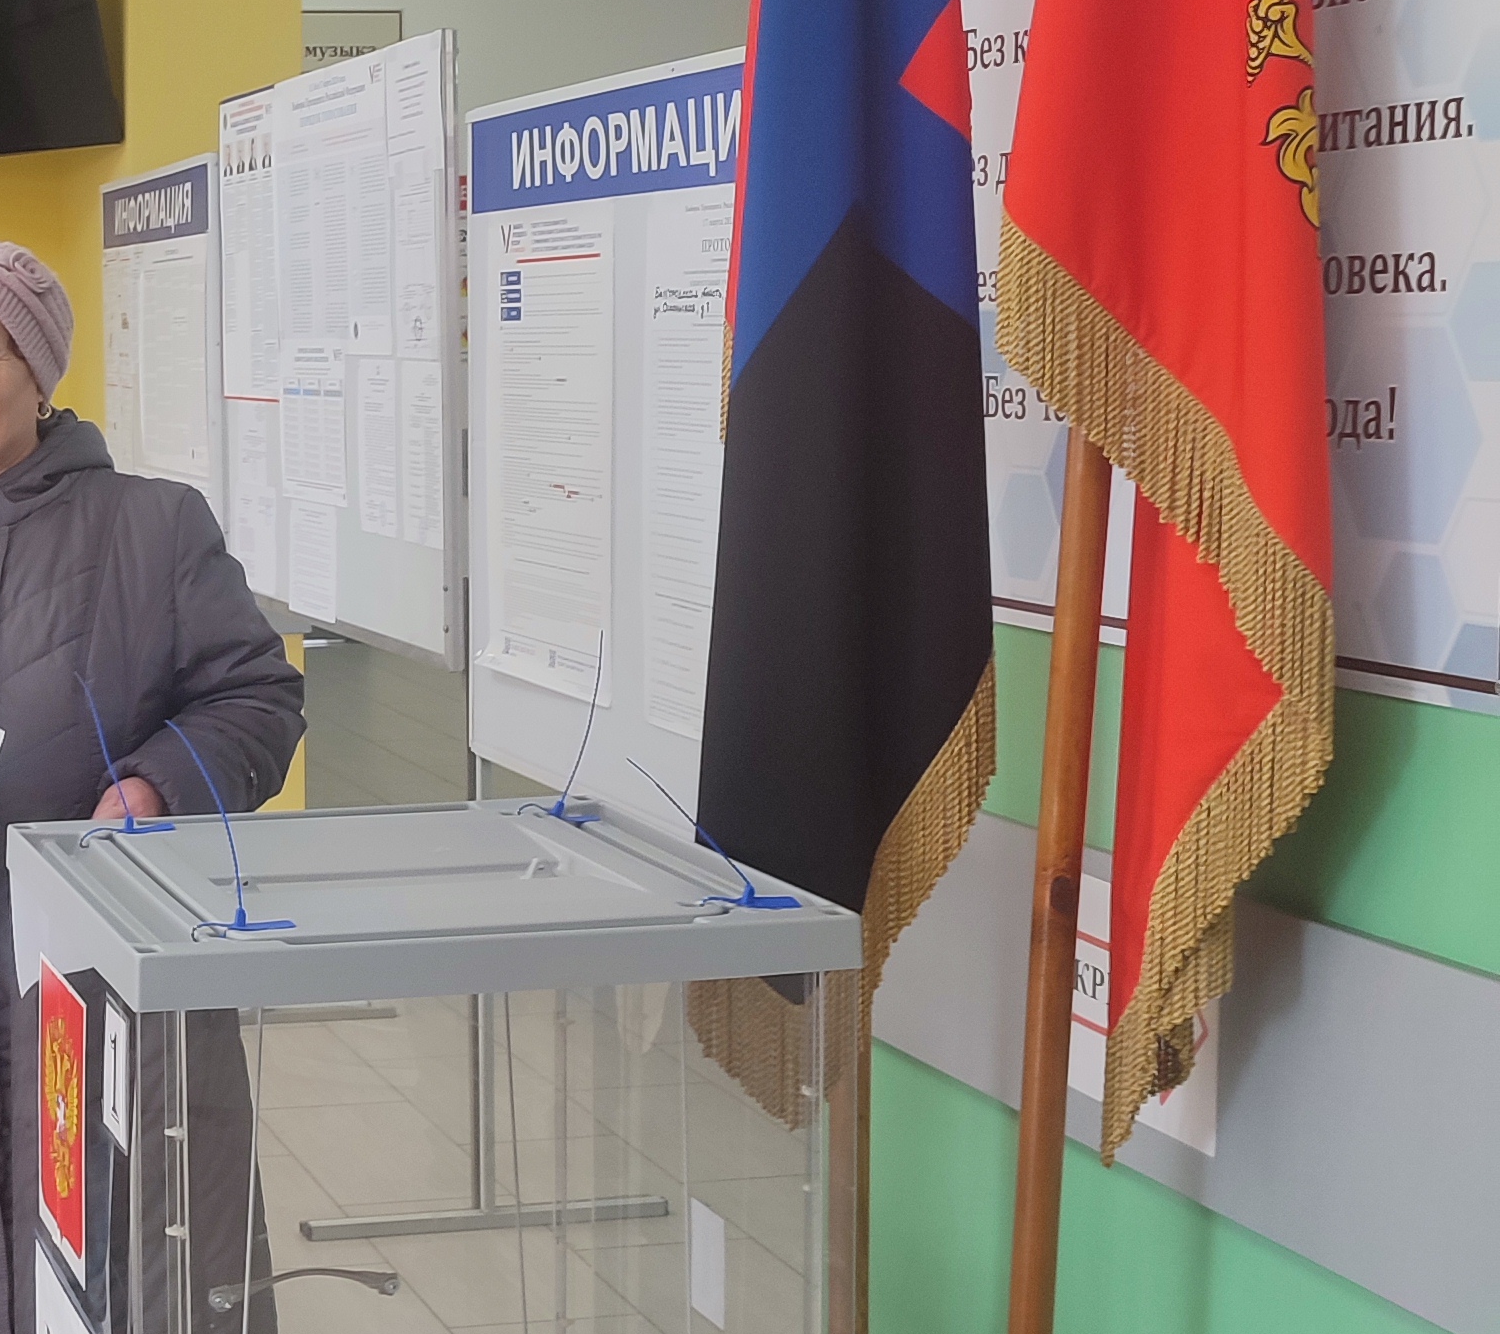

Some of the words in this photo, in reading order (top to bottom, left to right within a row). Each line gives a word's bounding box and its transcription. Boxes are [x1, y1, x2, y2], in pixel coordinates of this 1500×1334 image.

[965, 29, 1005, 72] Без
[511, 89, 742, 190] ИНФОРМАЦИ
[1317, 97, 1474, 154] итания.
[114, 181, 193, 236] ИНФОРМАЦИЯ
[983, 375, 1027, 420] Без
[1074, 957, 1111, 1005] КР
[109, 1031, 120, 1125] 1
